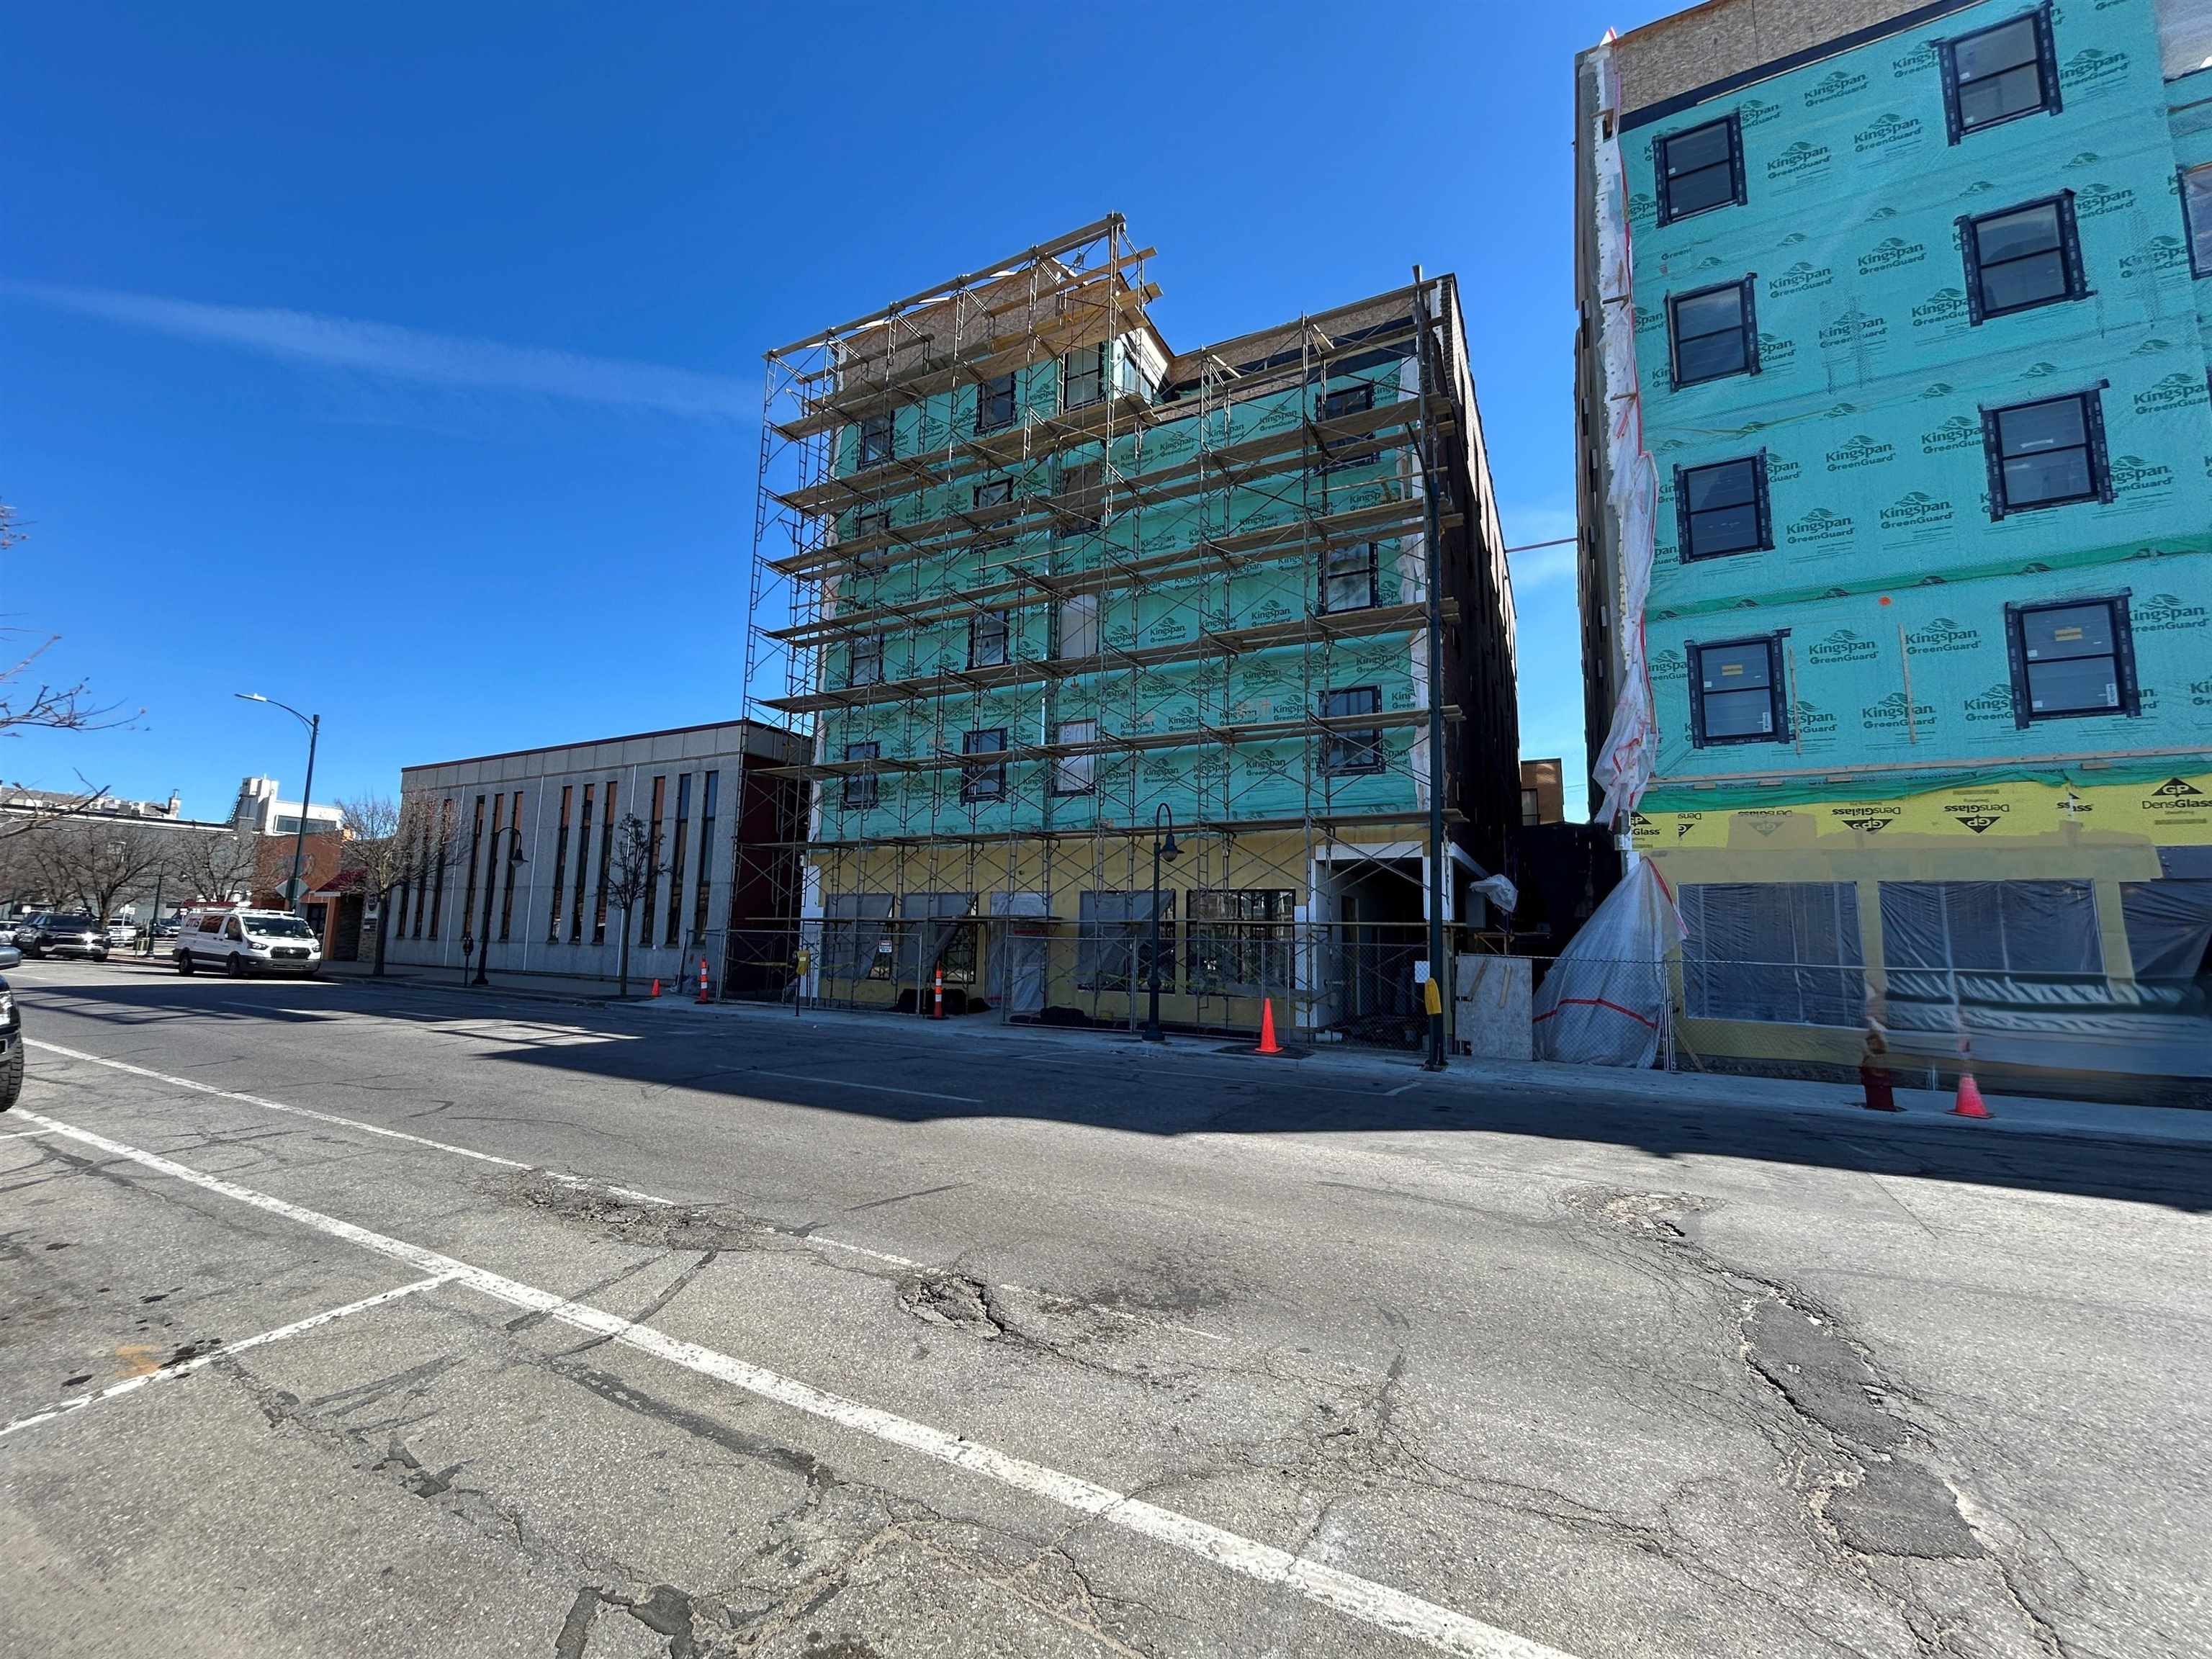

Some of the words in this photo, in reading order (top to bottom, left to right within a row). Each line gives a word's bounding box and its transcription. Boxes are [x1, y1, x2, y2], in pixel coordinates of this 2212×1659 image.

[2060, 51, 2128, 79] ingspan
[2061, 62, 2131, 89] reenGuard
[1804, 73, 1866, 99] Kingspan
[1805, 82, 1869, 107] GreenGuard
[1740, 103, 1779, 125] gspan
[1853, 117, 1919, 144] Kingspan
[1855, 127, 1923, 153] GreenGuard
[1767, 145, 1828, 171] Kingspan
[1768, 155, 1832, 179] GreenGuard
[2075, 188, 2134, 210] ngspan
[1858, 243, 1923, 266] Kingspan
[1859, 253, 1927, 275] GreenGuard
[1769, 267, 1831, 289] Kingspan
[1770, 276, 1835, 298] GreenGuard
[1911, 299, 1967, 318] Kingspa
[1912, 310, 1969, 328] GreenGua
[2134, 384, 2207, 404] Kingspa
[2136, 396, 2208, 414] GreenGuar
[1259, 410, 1297, 423] Kingspan
[1921, 426, 1982, 444] Kingspa
[1160, 438, 1194, 451] Kingspan
[1825, 442, 1894, 463] Kingspan
[1923, 439, 1984, 454] GreenGuar
[1120, 449, 1153, 460] Kingpan
[1827, 454, 1896, 472] GreenGuard
[1768, 461, 1799, 475] span
[1769, 471, 1802, 484] Guard
[1879, 500, 1952, 520] Kingspan
[1786, 516, 1854, 535] Kingspan
[1881, 512, 1954, 529] GreenGuard
[1787, 527, 1855, 544] GreenGuard
[1251, 608, 1290, 620] Kingspan
[2130, 605, 2208, 623] ingspan
[1150, 625, 1185, 637] Kingspan
[2131, 619, 2210, 633] reenGuard
[1150, 634, 1186, 644] GreenGuard
[1905, 628, 1980, 645] Kingspan
[1809, 641, 1876, 655] Kingspan
[1906, 640, 1981, 655] GreenGuard
[1356, 655, 1400, 665] Kingspan
[1647, 661, 1687, 673] ingspa
[1809, 652, 1879, 665] GreenGuard
[1243, 670, 1281, 680] Kingspan
[1142, 683, 1175, 693] Kingspan
[1964, 698, 2010, 713] Kings
[1966, 711, 2014, 721] GreenG
[1246, 759, 1285, 768] Kingspan
[1143, 768, 1179, 777] Kingspan
[2163, 785, 2188, 794] GP
[1945, 804, 2010, 812] DensGlass
[1967, 818, 1990, 827] GP
